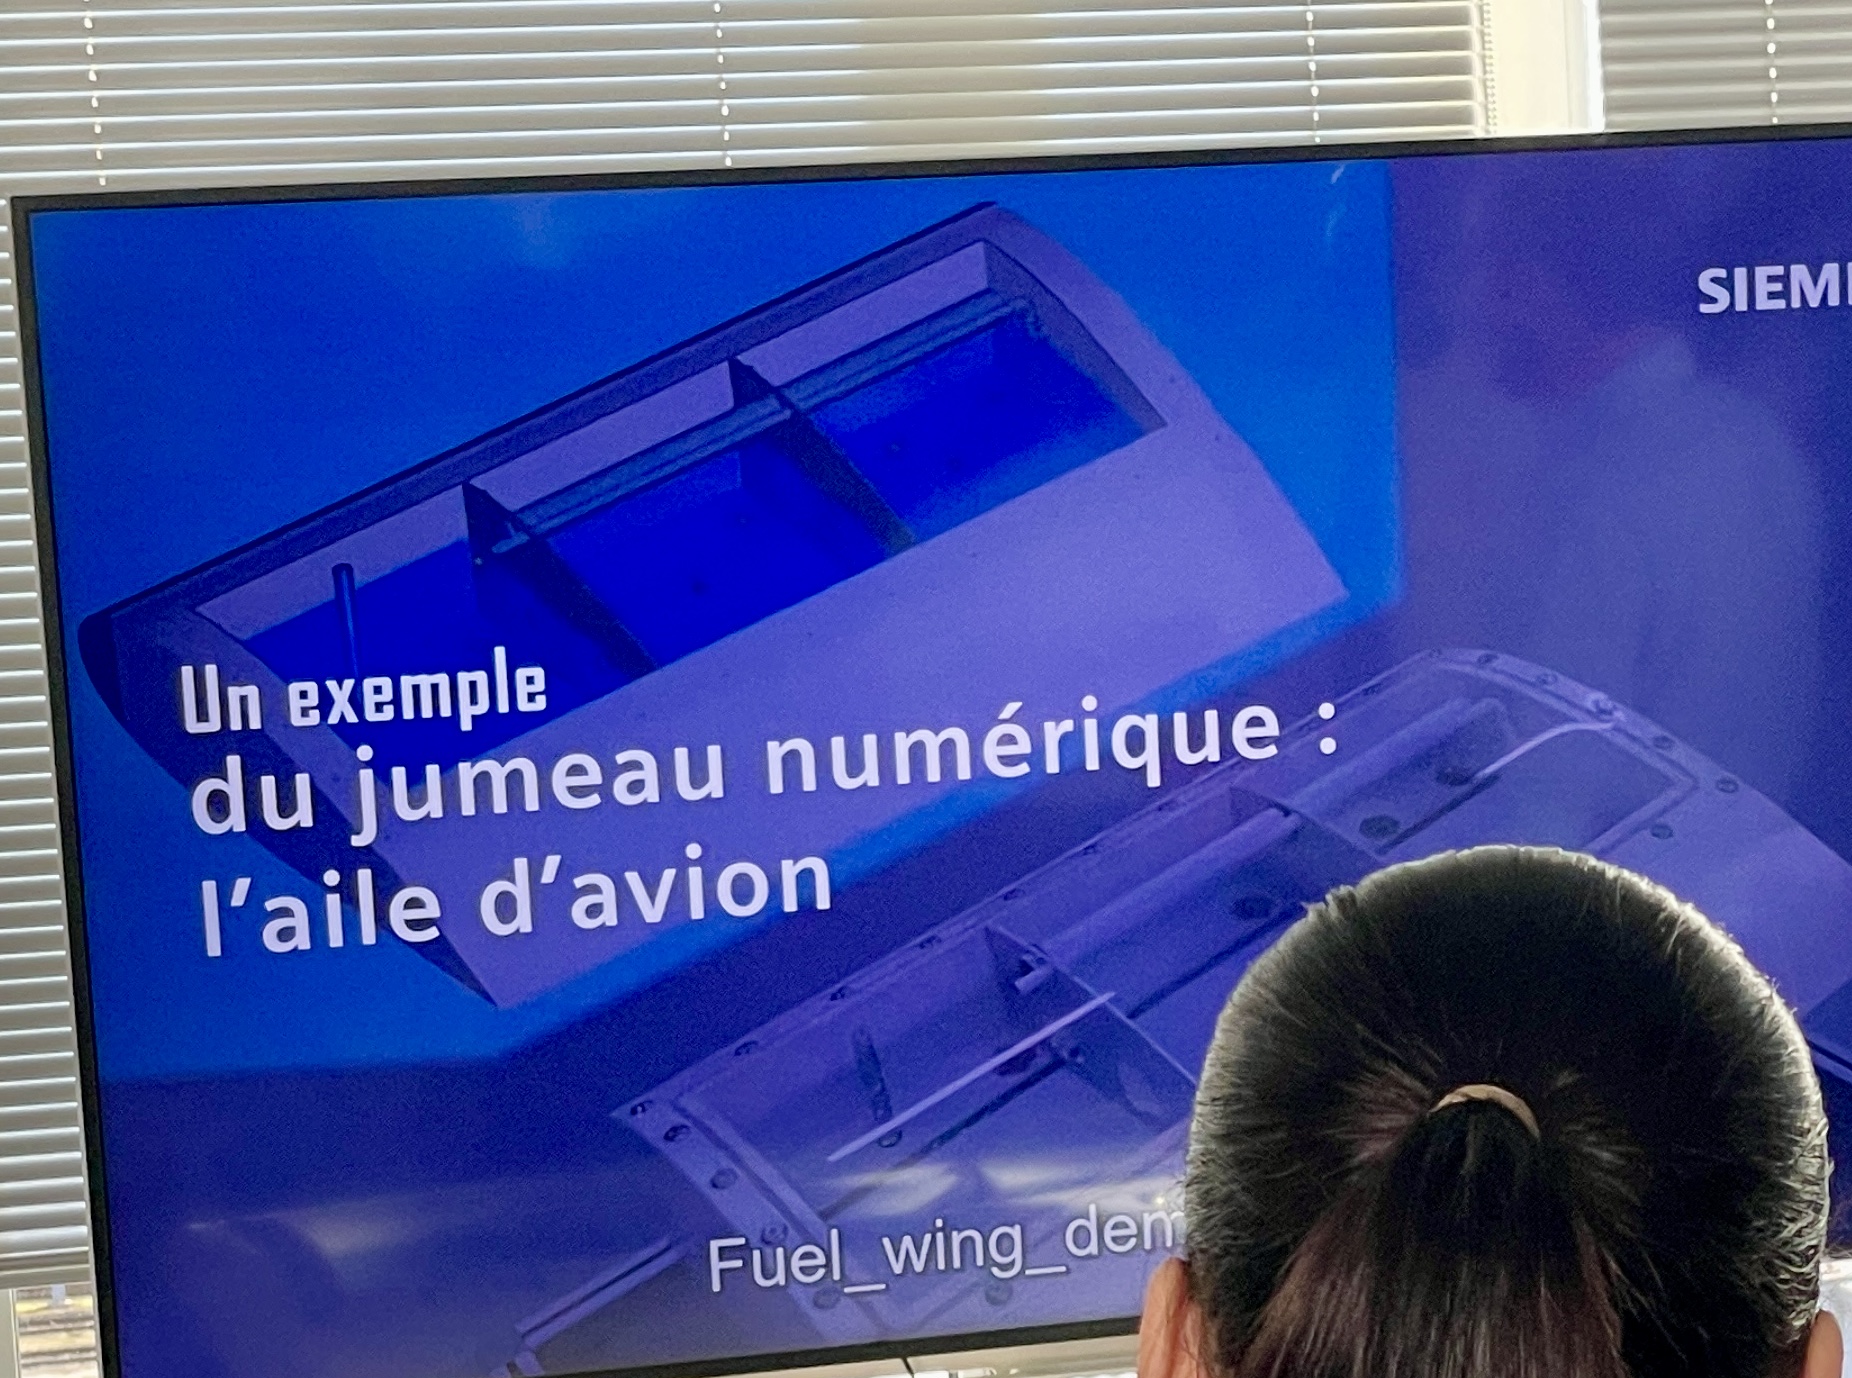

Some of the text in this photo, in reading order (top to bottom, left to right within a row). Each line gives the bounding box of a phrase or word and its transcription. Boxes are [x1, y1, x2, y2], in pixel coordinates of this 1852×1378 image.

[180, 646, 547, 734] Un exemple
[191, 695, 1336, 847] du jumeau numérique :
[201, 843, 831, 957] l’aile d’avion
